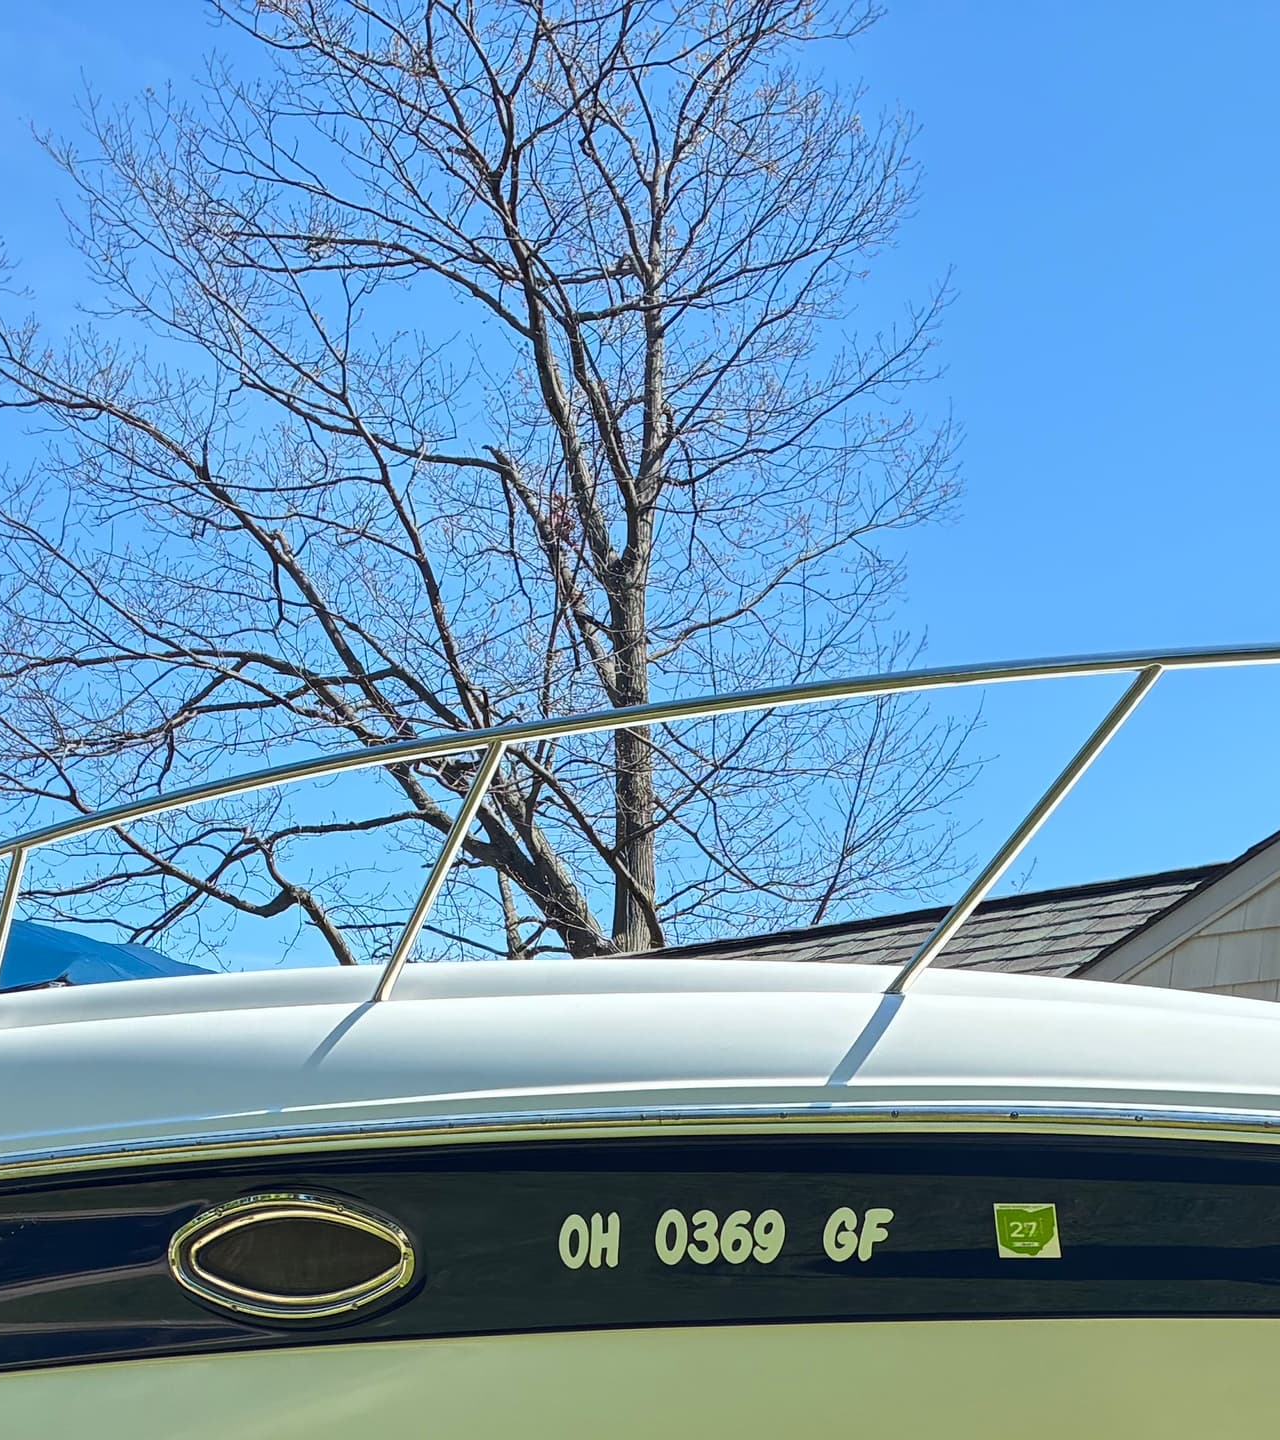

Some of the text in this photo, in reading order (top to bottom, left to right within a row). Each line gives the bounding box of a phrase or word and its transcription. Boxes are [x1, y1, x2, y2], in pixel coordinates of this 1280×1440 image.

[558, 1206, 895, 1269] OH 0369 GF
[1009, 1221, 1038, 1238] 27
